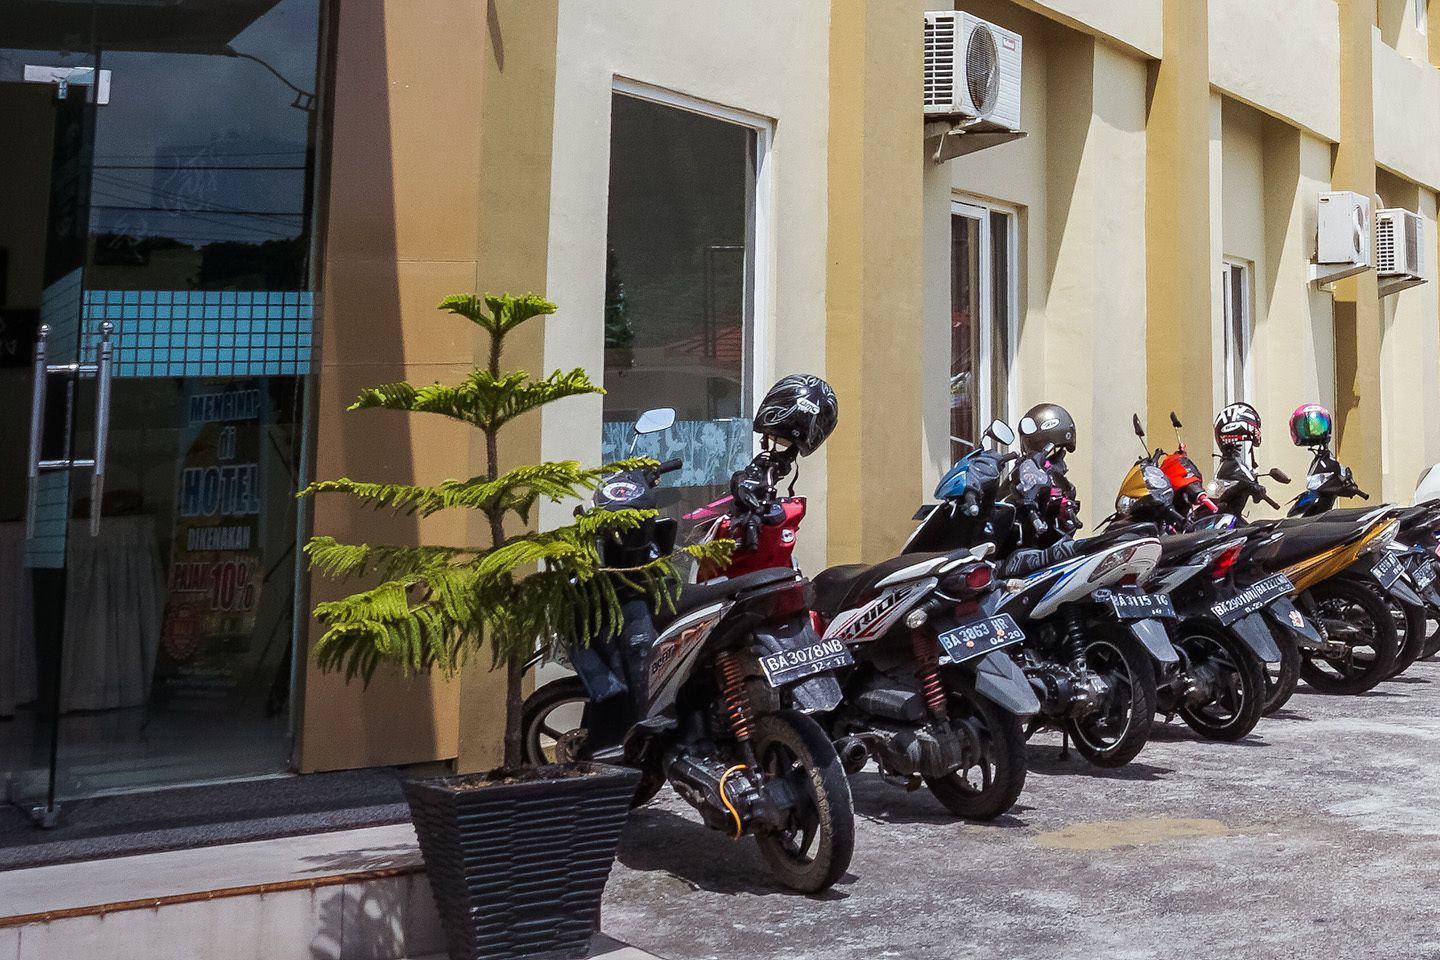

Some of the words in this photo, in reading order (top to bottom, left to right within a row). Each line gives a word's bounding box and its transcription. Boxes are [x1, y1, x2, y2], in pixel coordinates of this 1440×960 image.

[181, 464, 260, 517] HOTEL
[942, 633, 963, 649] BA
[958, 622, 990, 642] 3863
